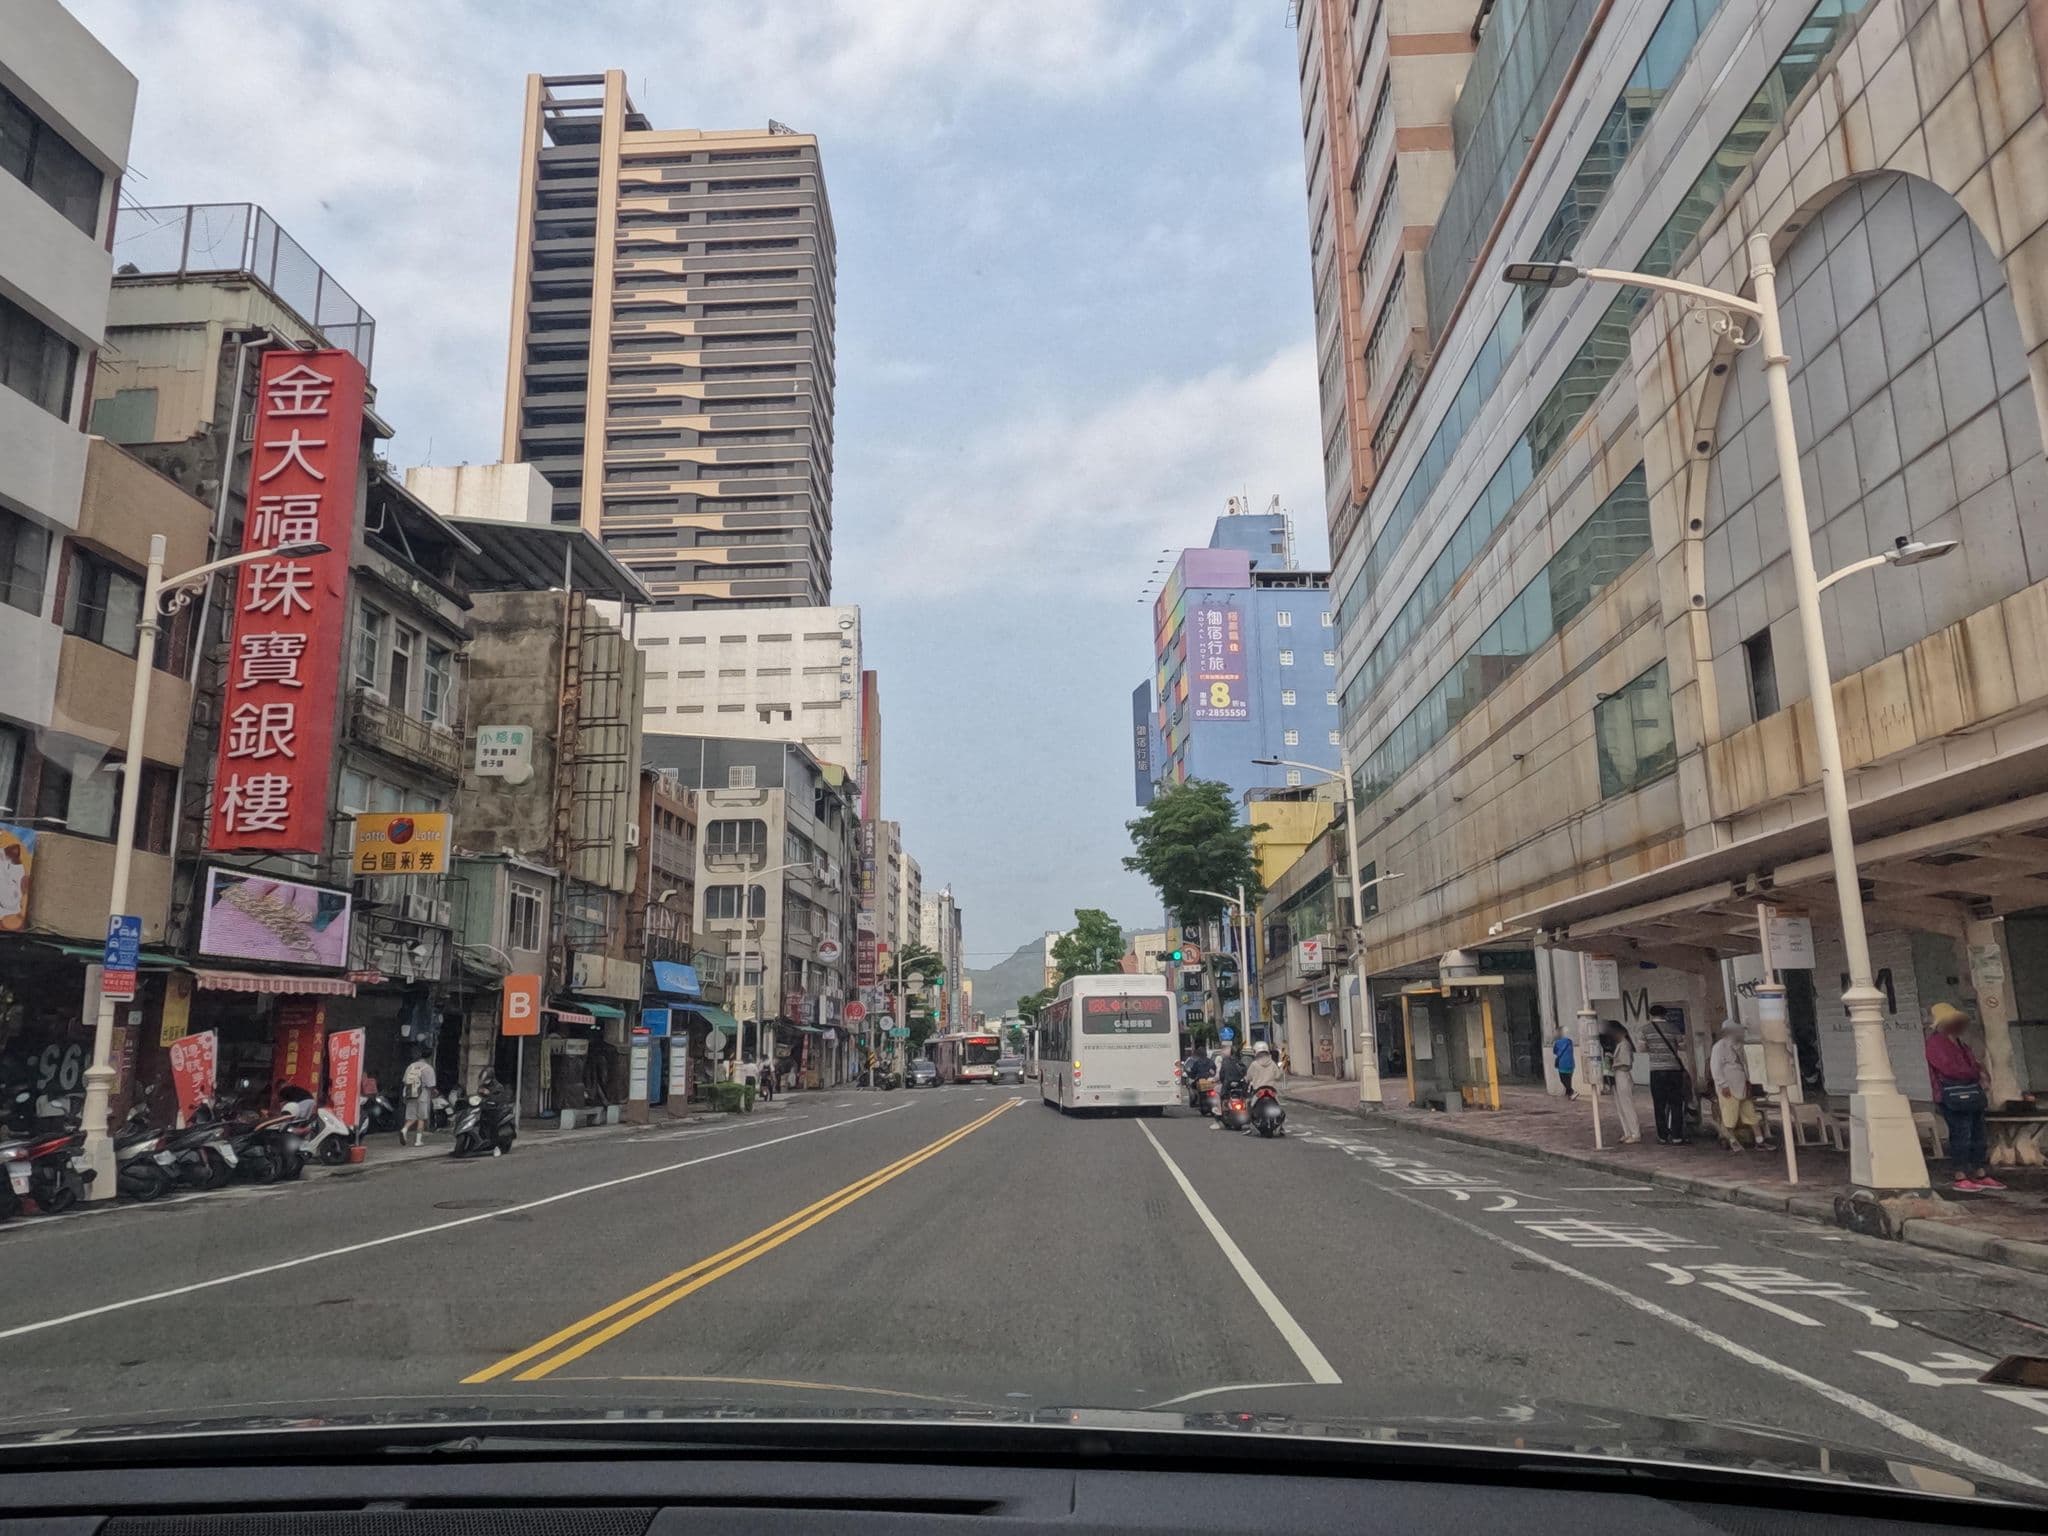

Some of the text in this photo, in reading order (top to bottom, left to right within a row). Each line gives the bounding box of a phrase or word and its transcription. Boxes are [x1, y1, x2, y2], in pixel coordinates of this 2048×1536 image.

[218, 363, 335, 834] 金大福珠寶銀樓
[1206, 608, 1225, 672] 御宿行旅
[1210, 681, 1231, 708] 8
[1195, 709, 1247, 718] 07-2855550
[361, 850, 435, 871] 台灣彩券
[109, 916, 123, 936] P
[509, 992, 531, 1019] B
[1622, 987, 1651, 1022] M
